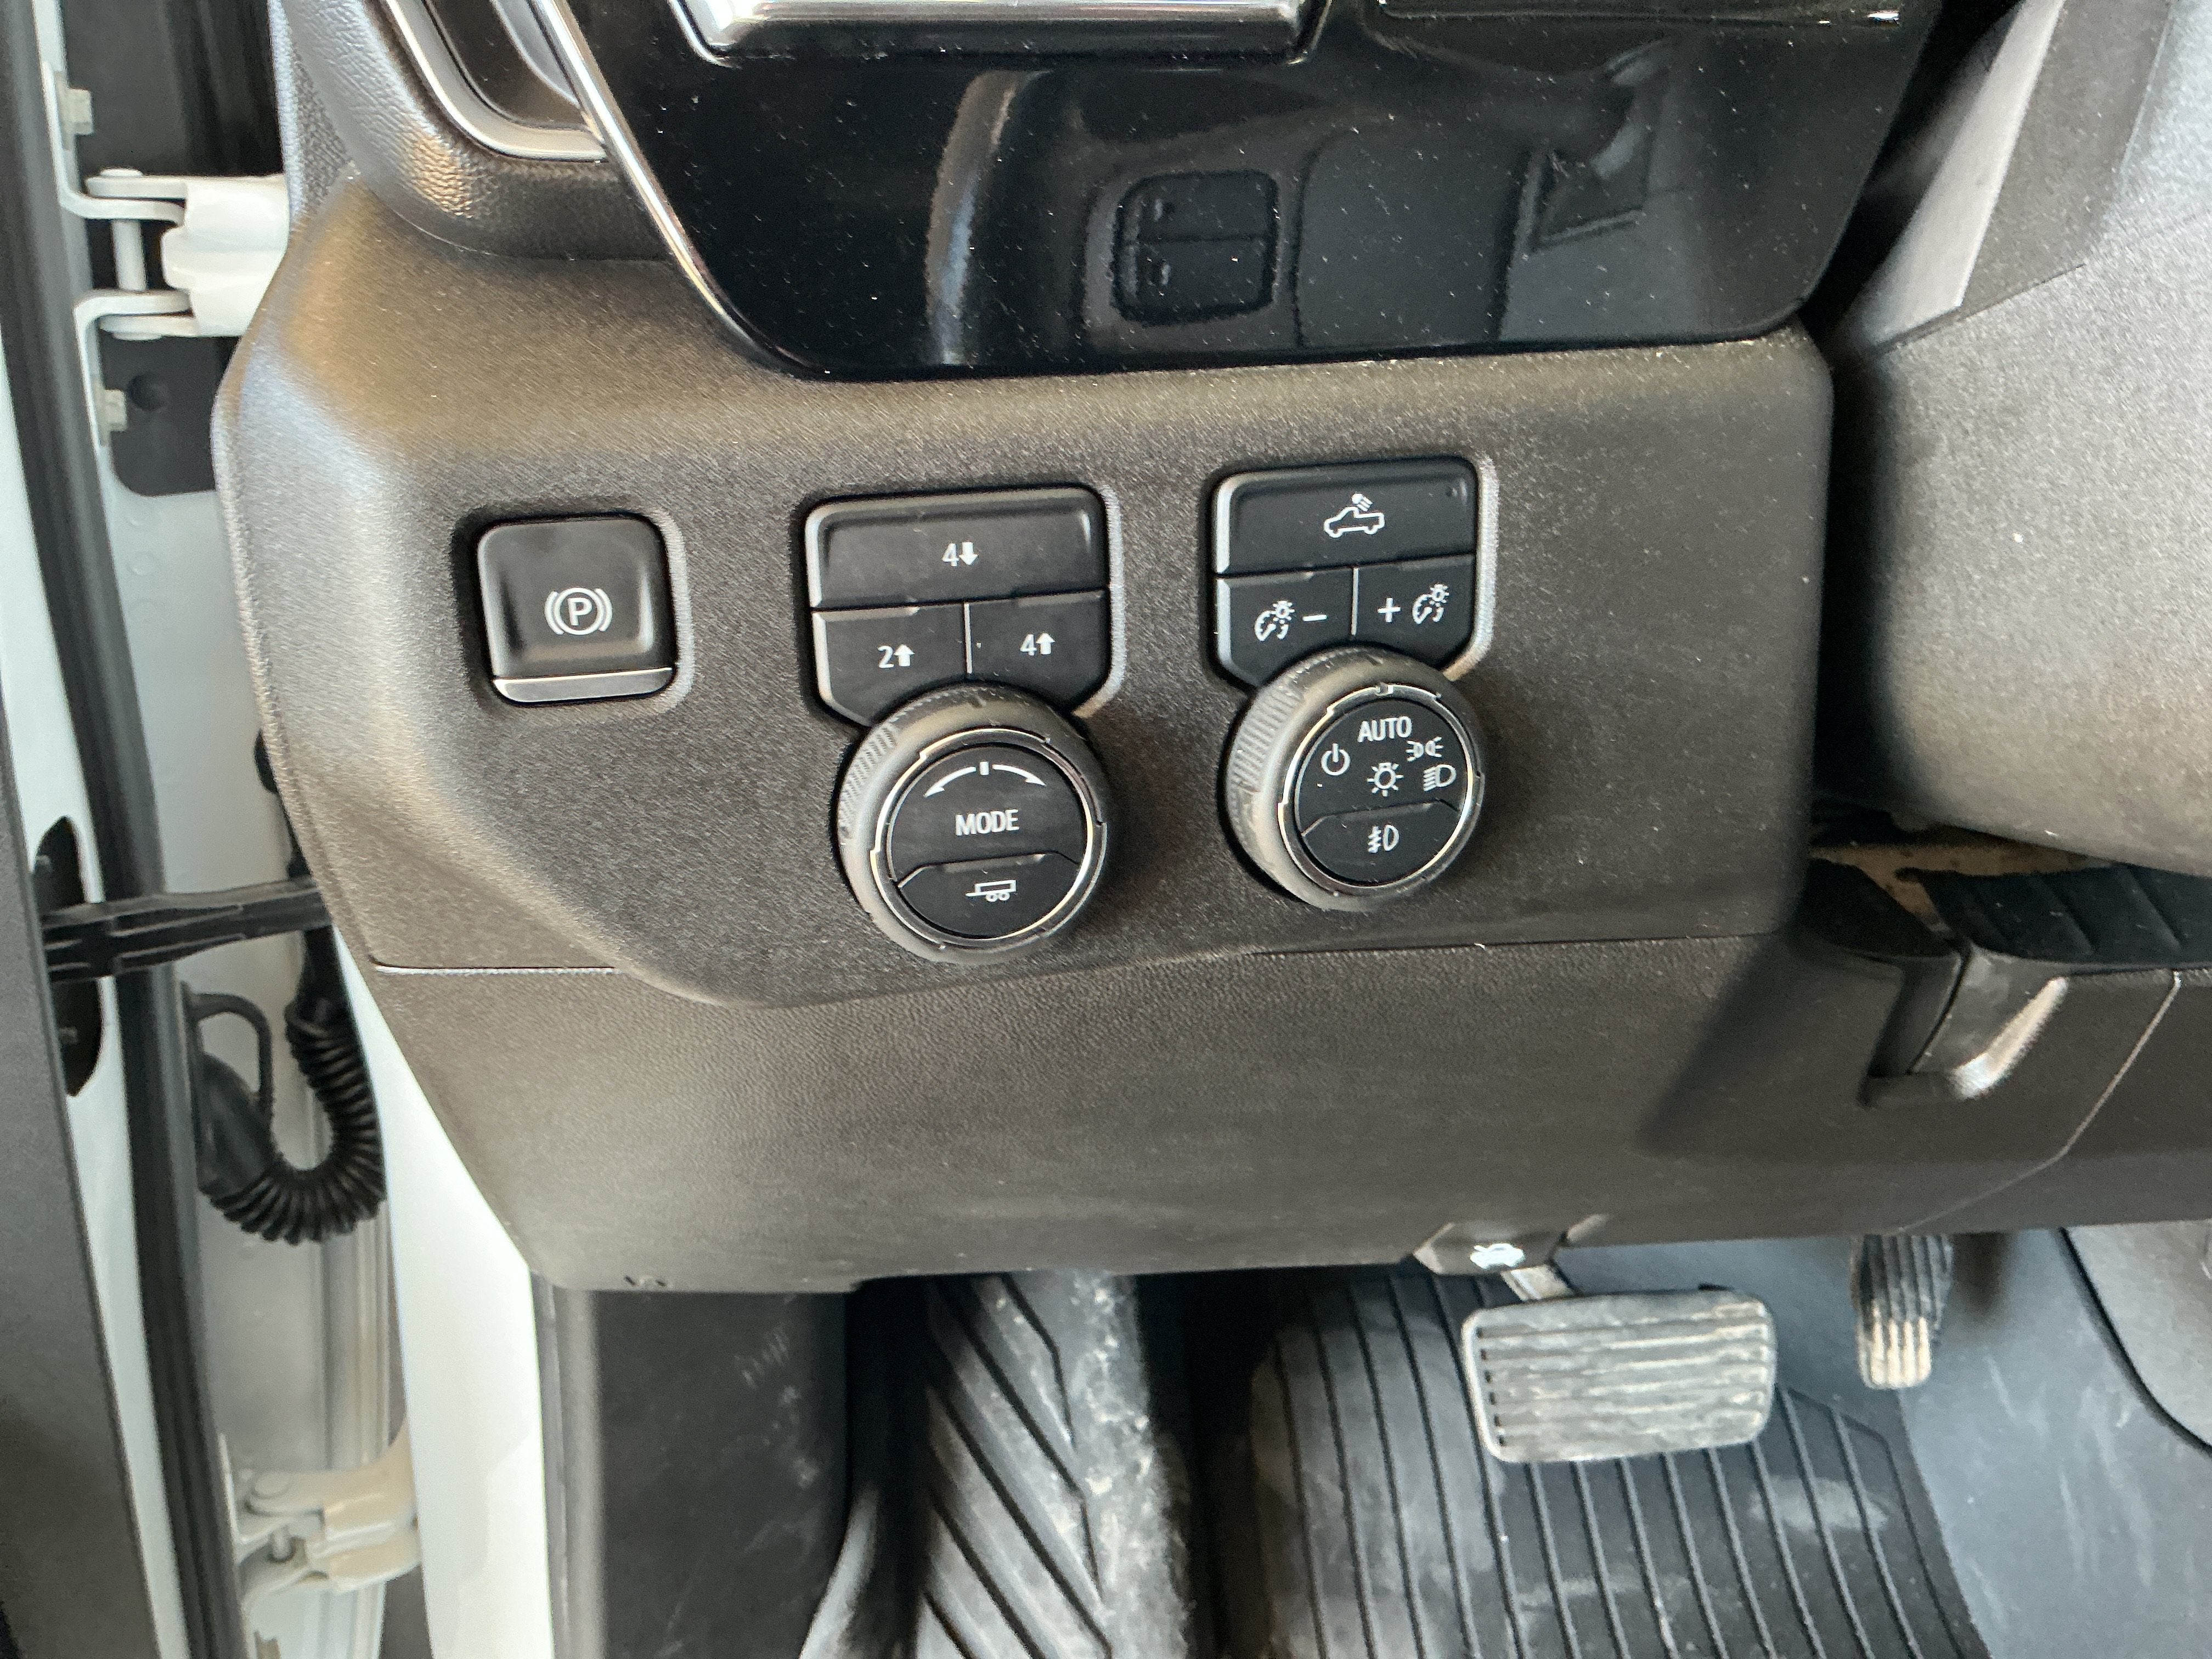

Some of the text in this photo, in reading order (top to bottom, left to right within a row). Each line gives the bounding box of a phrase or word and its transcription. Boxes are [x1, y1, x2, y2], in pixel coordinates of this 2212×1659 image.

[941, 542, 960, 567] 4
[567, 596, 592, 626] P
[877, 645, 894, 669] 2
[1019, 634, 1037, 657] 4
[1357, 715, 1413, 743] AUTO
[955, 809, 1020, 836] MODE
